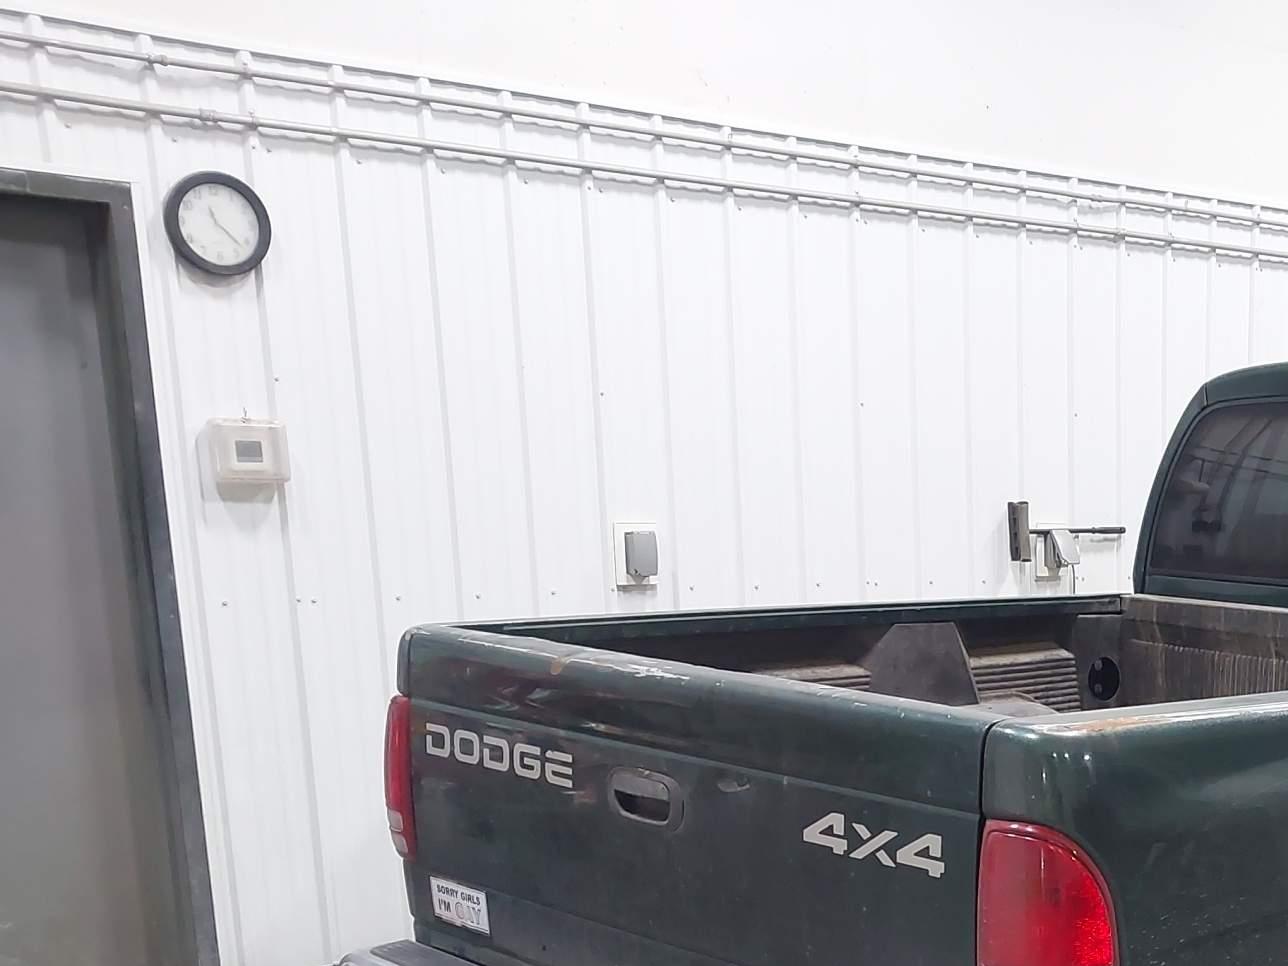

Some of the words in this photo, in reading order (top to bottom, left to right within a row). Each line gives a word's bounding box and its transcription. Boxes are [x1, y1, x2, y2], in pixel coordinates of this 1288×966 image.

[425, 722, 574, 789] DODGE
[436, 884, 459, 898] SORRY
[460, 892, 481, 905] GIRLS
